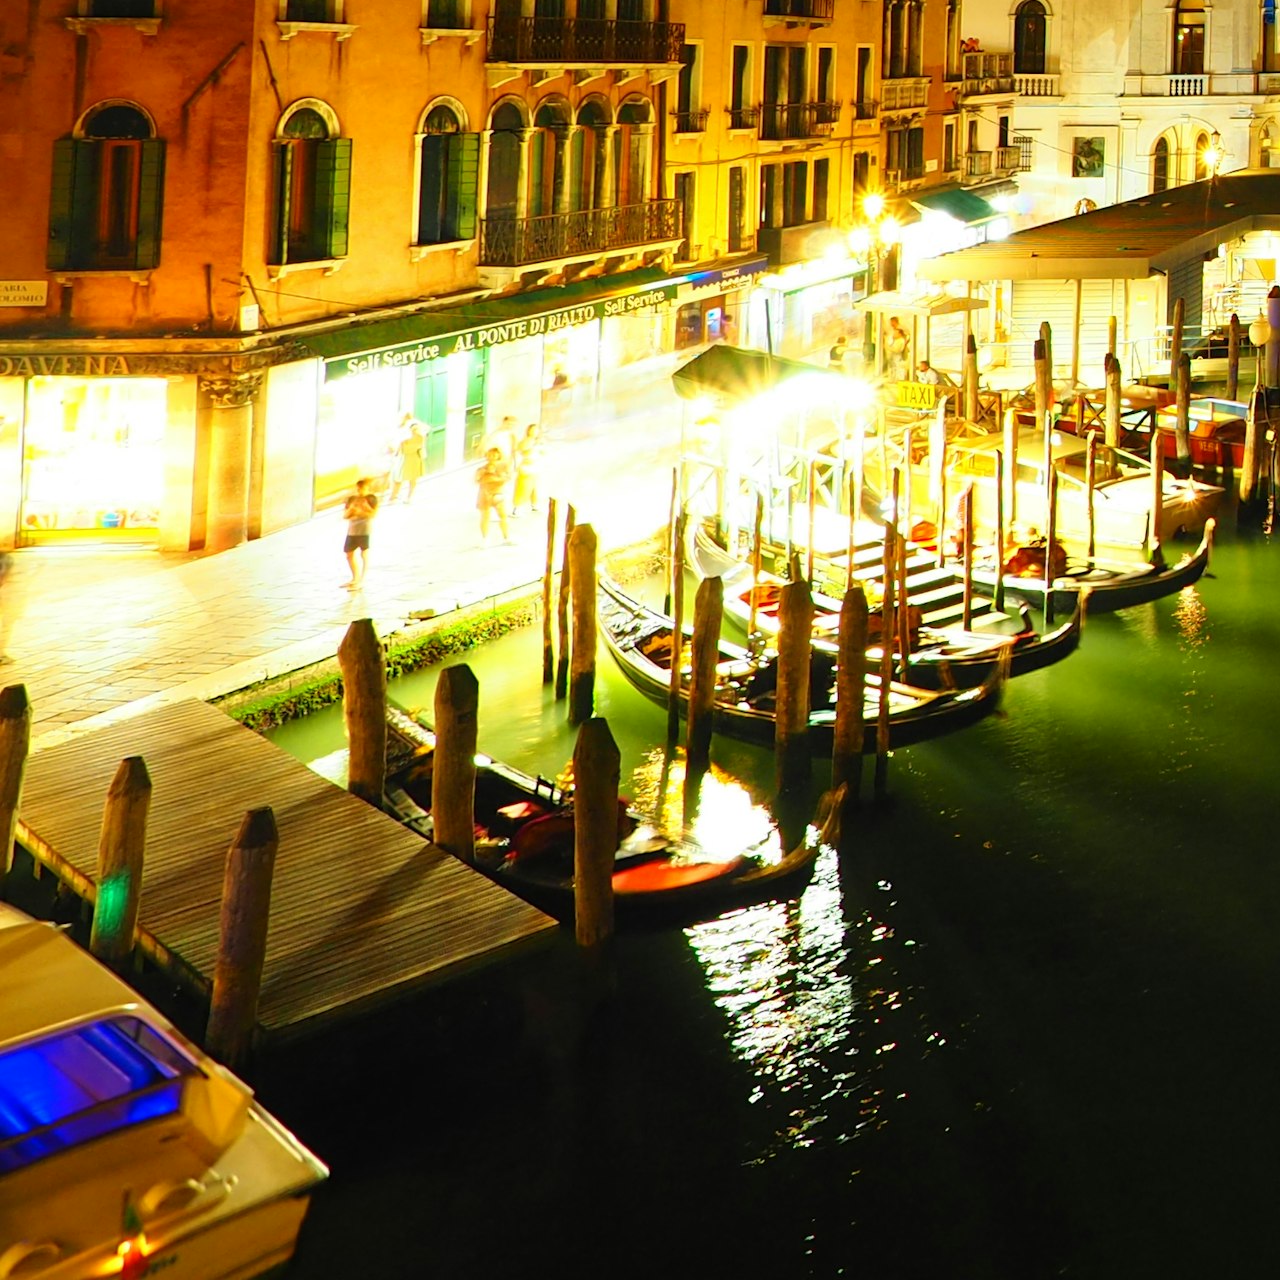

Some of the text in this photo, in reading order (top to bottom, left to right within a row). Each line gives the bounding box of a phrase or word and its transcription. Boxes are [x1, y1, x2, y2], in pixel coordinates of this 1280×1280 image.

[346, 289, 666, 376] Self Service AL PONTE DI RIALTO Self Service
[902, 386, 931, 405] TAXI
